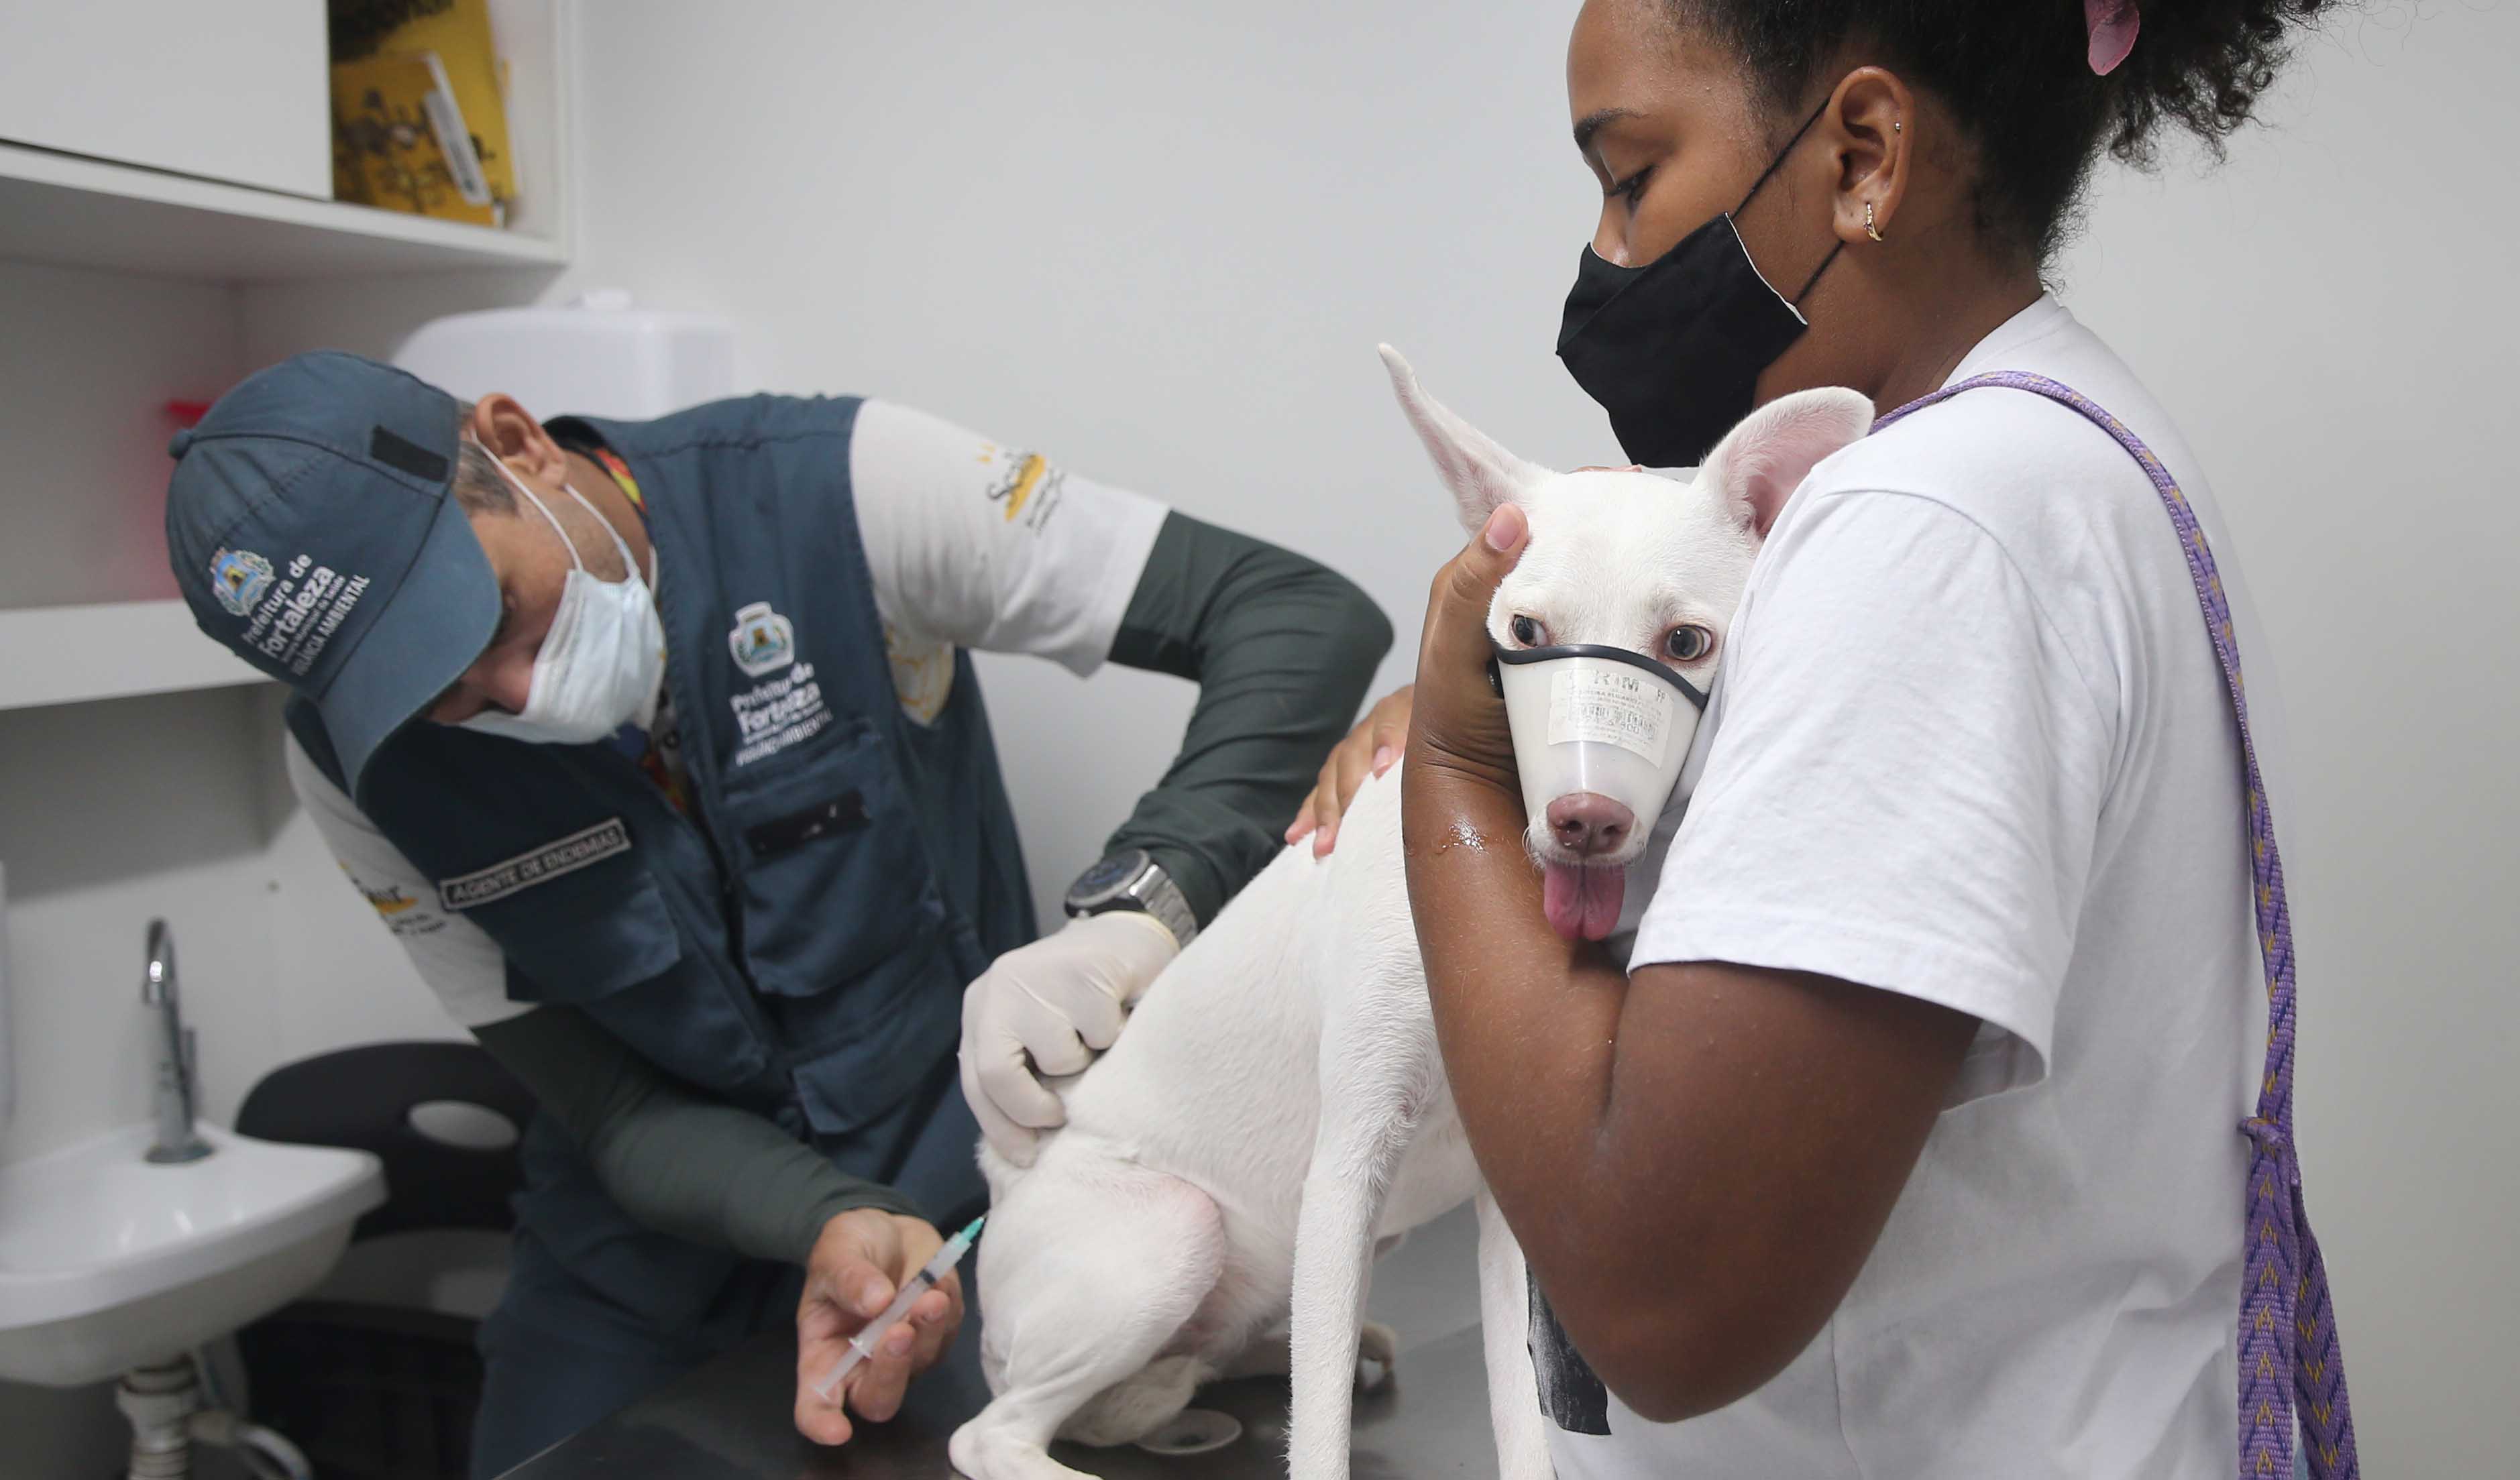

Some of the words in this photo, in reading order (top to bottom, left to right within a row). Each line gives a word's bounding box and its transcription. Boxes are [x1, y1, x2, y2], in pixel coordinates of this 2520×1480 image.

[241, 579, 295, 645] Prefeitura
[288, 554, 313, 578] de
[258, 566, 337, 659] Fortaleza
[317, 574, 371, 638] AMBIENTAL
[452, 867, 518, 901] AGENTE
